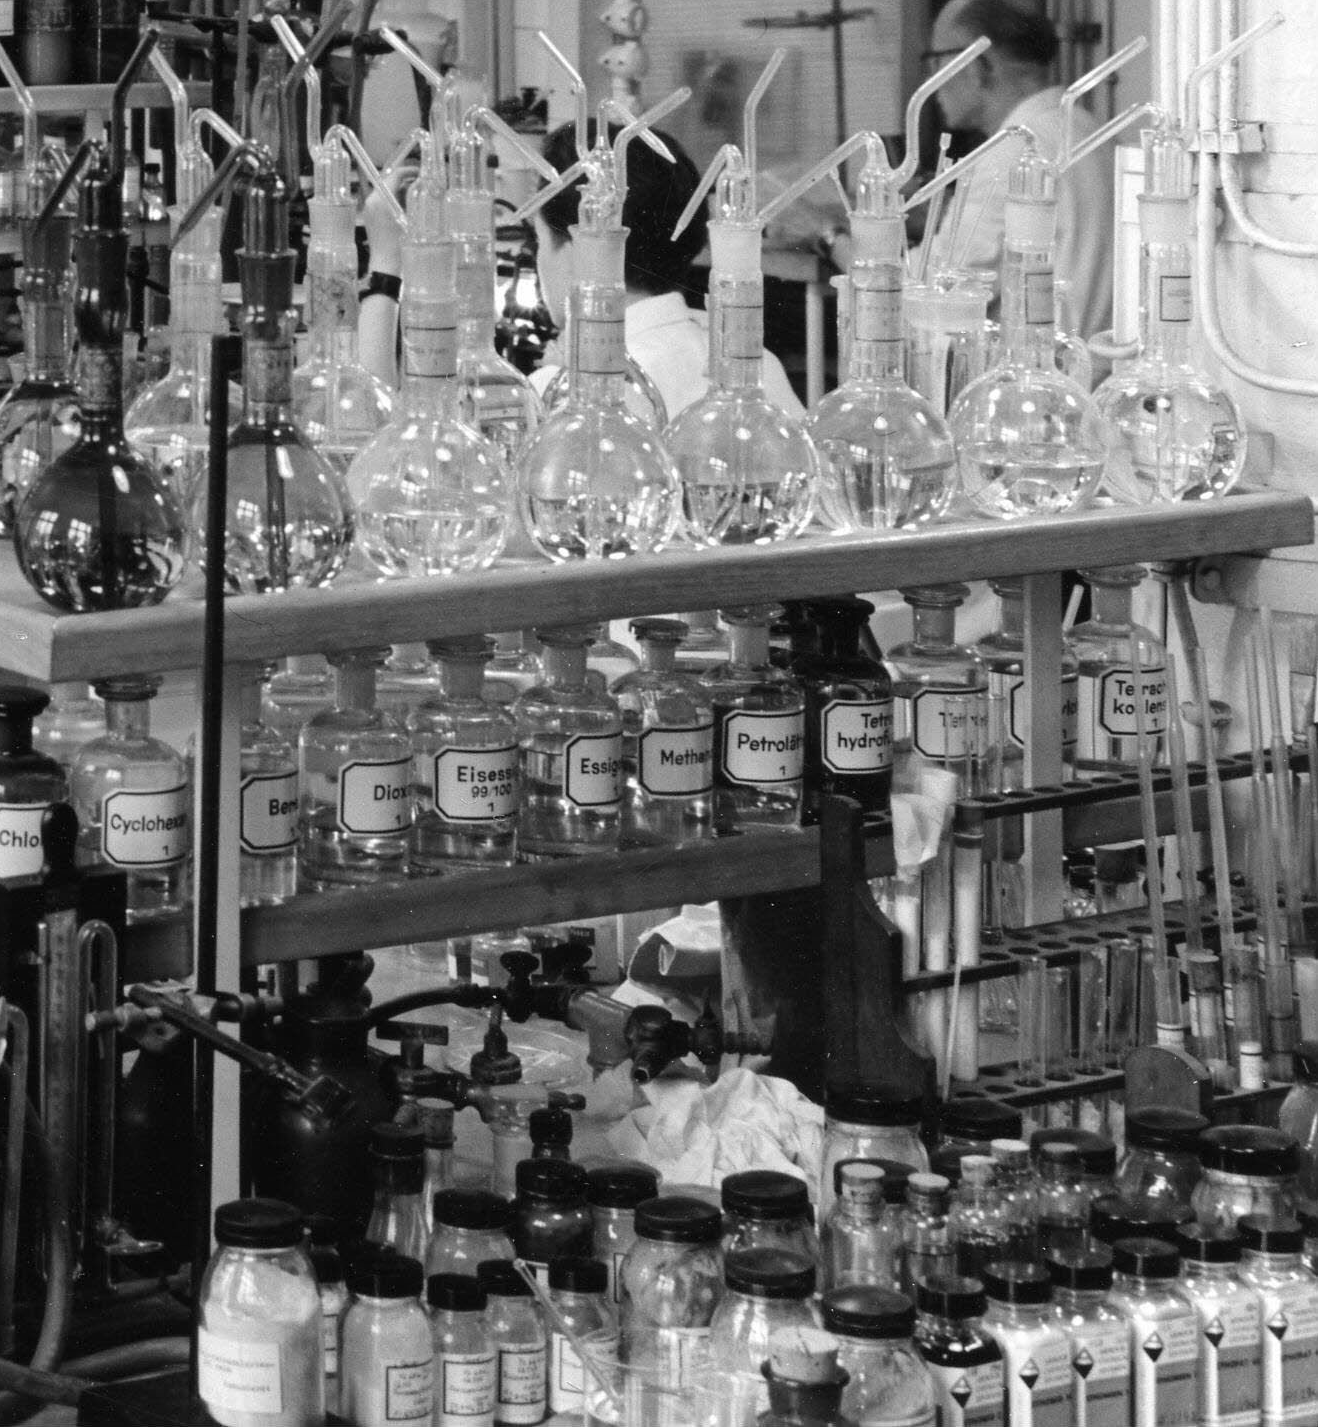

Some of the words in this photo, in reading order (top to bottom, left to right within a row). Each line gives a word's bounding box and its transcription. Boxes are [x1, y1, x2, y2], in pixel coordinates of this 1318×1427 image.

[779, 765, 786, 776] 1
[487, 802, 495, 813] 1
[395, 813, 402, 825] 1
[162, 844, 169, 856] 1
